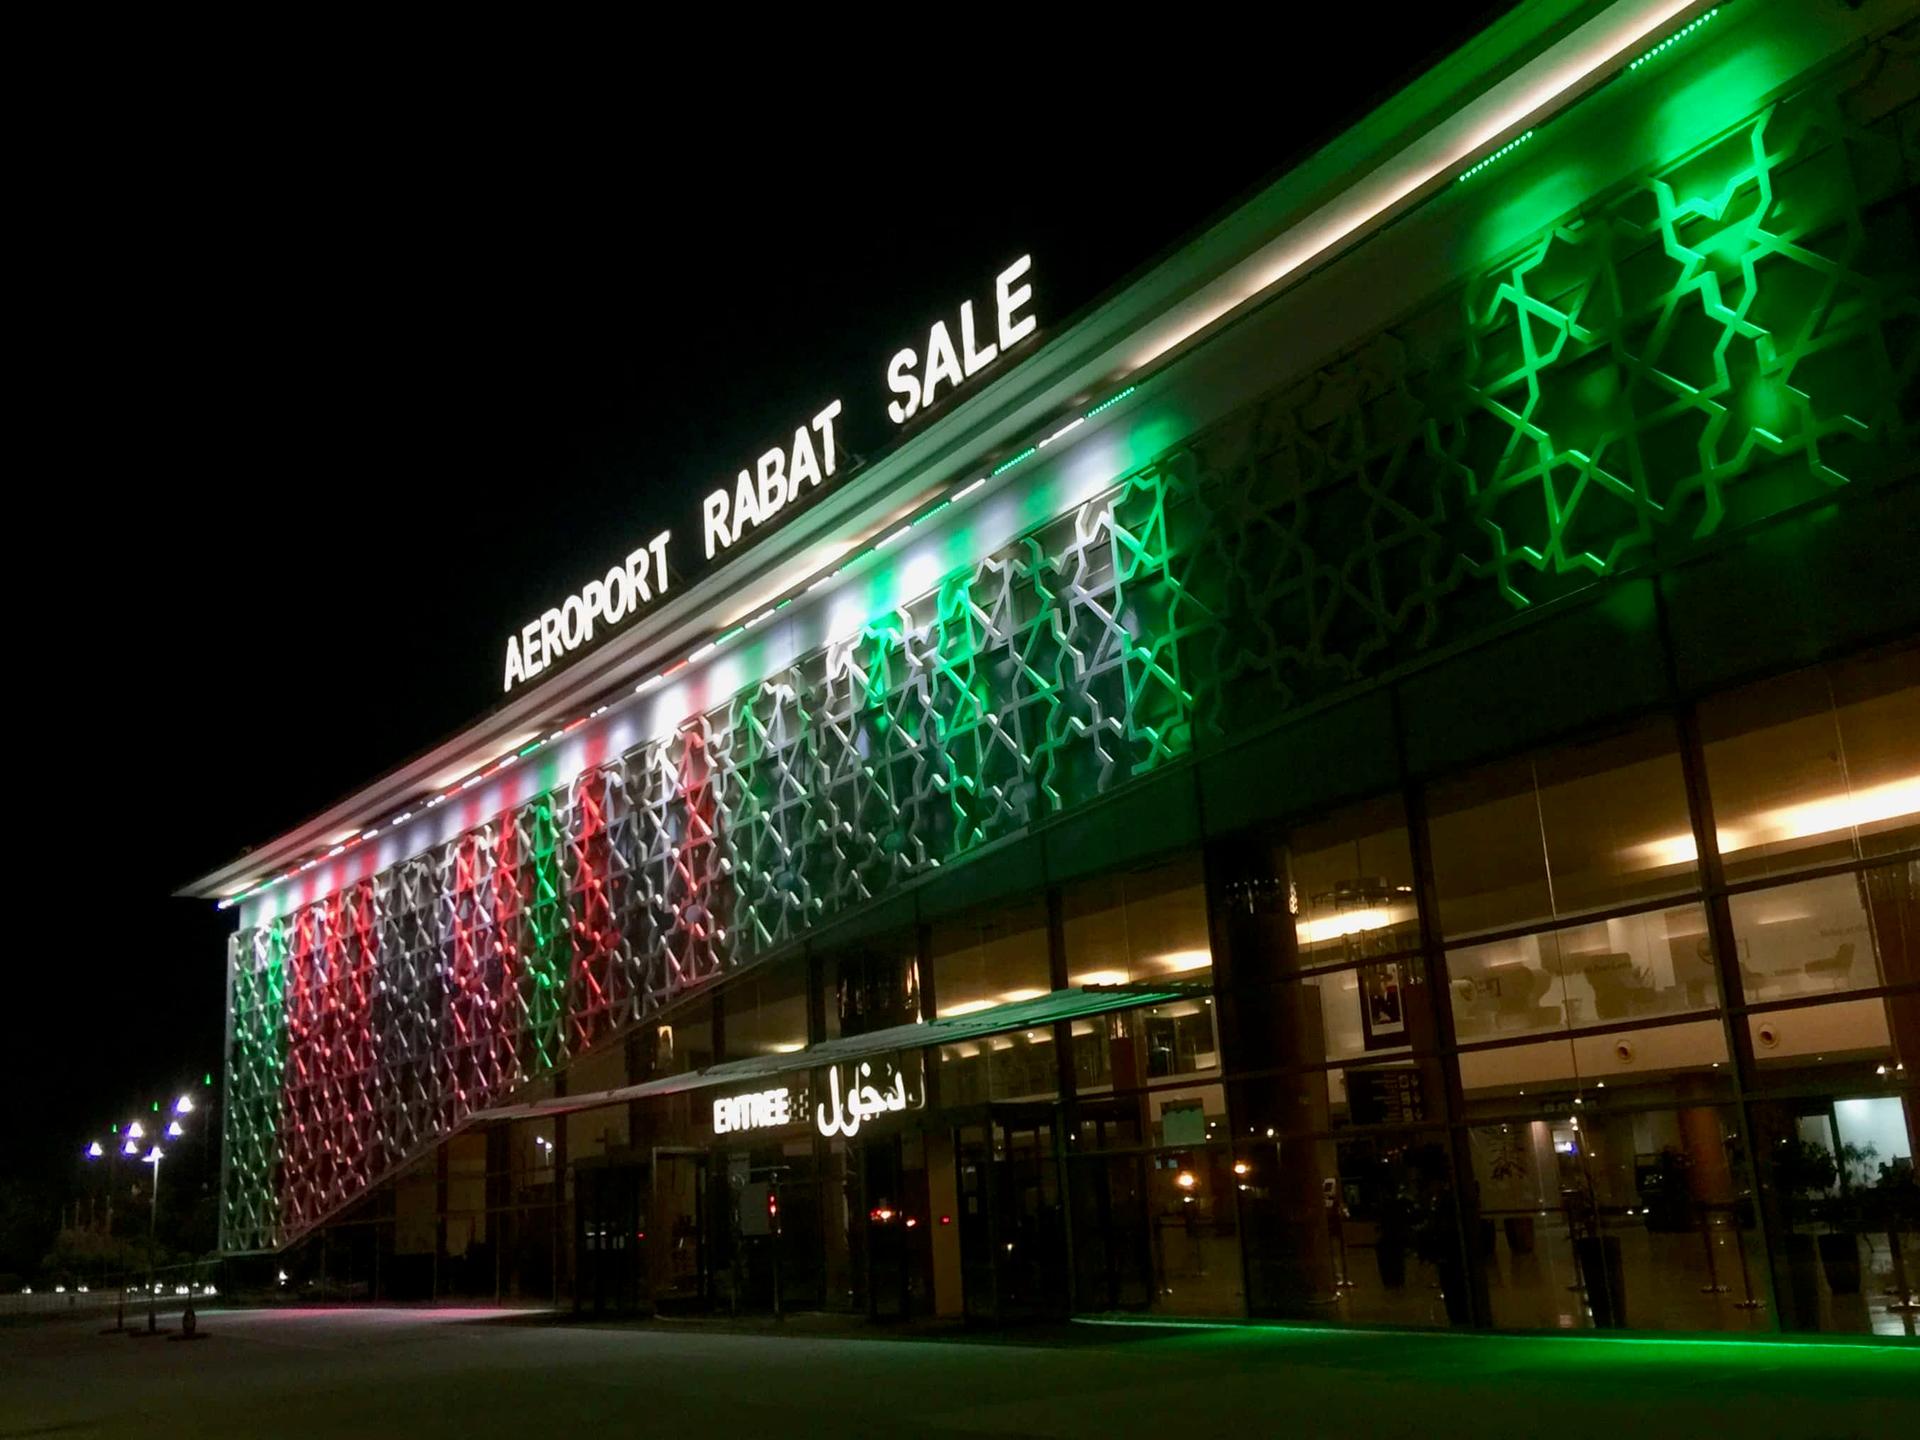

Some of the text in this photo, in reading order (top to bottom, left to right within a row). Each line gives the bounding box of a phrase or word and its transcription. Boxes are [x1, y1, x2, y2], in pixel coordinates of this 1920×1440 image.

[503, 254, 1037, 692] AEROPORT RABAT SALE
[713, 1087, 791, 1134] ENTREE
